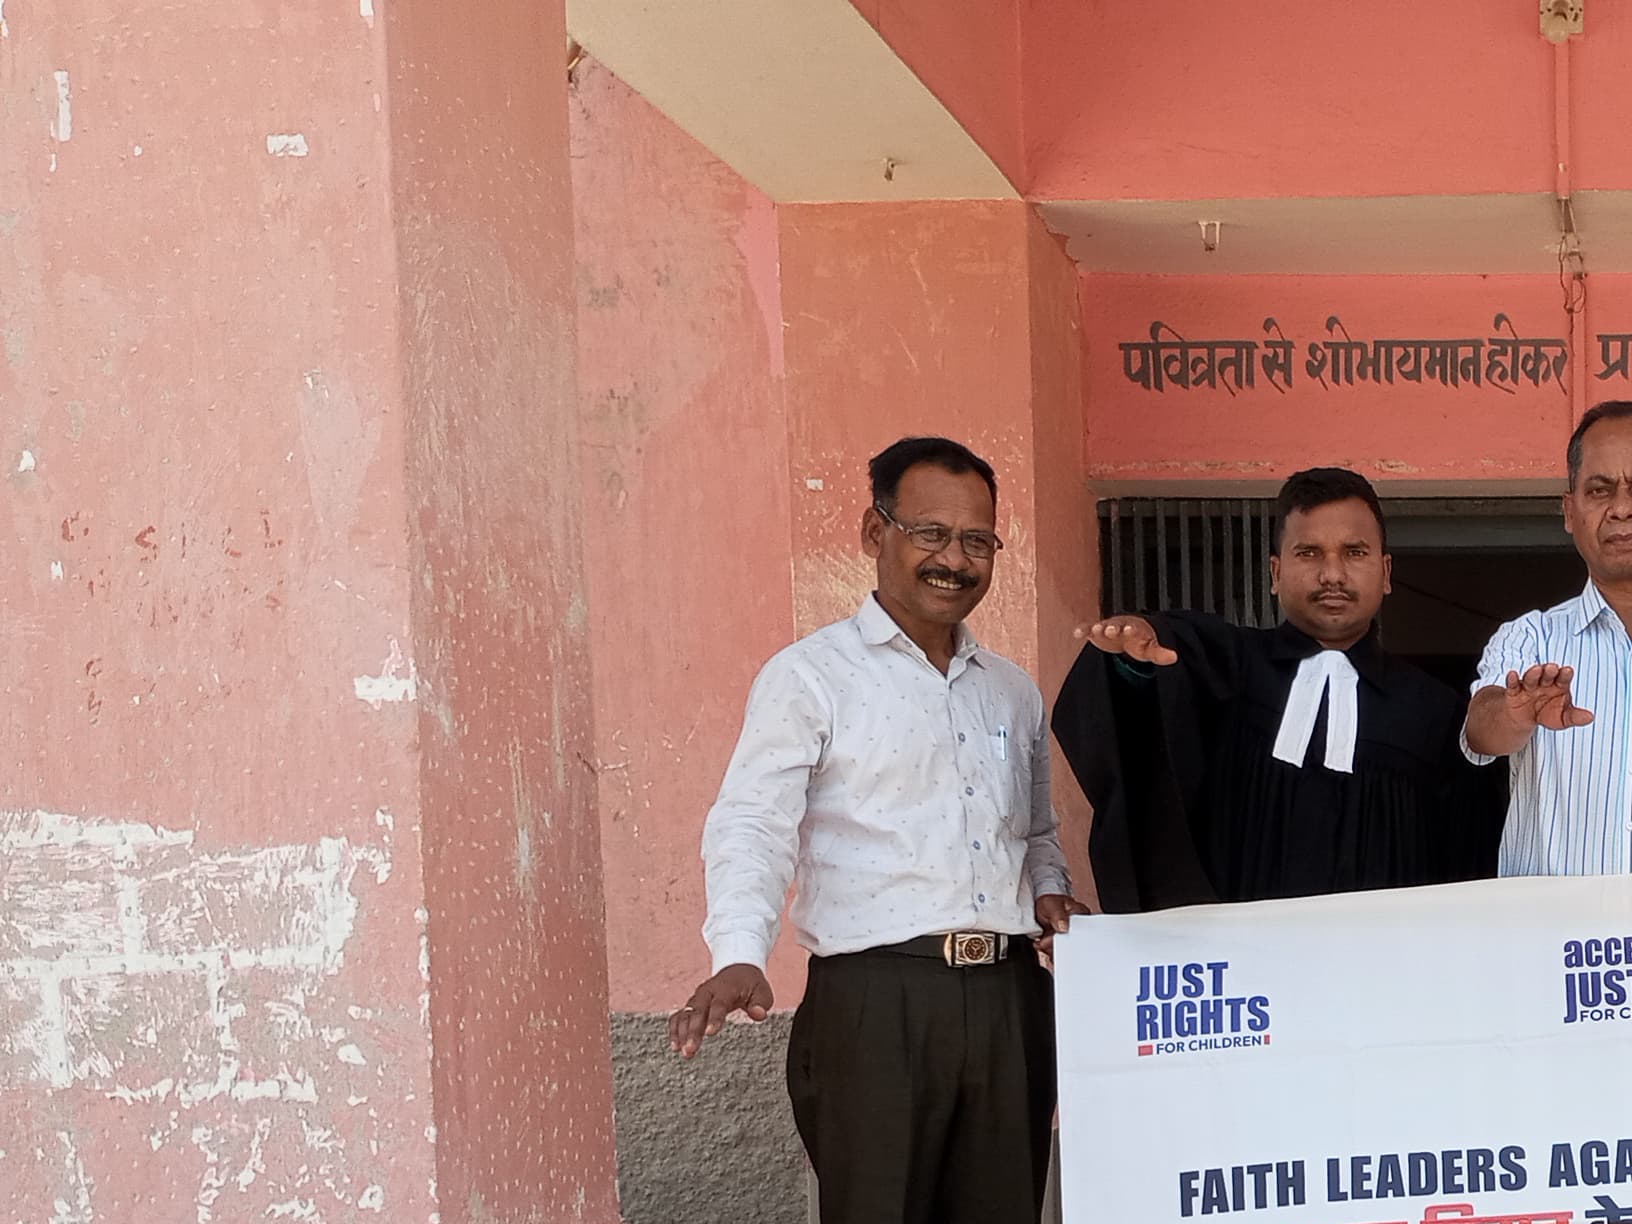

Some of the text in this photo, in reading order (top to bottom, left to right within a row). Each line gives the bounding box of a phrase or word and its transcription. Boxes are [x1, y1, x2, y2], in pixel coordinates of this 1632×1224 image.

[1119, 320, 1258, 397] पवित्रता
[1261, 317, 1294, 394] से
[1136, 961, 1229, 1003] JUST
[1136, 995, 1270, 1042] RIGHTS
[1580, 1008, 1615, 1022] FOR
[1156, 1035, 1262, 1055] FOR CHILDREN
[1180, 1160, 1305, 1218] FAITH
[1327, 1146, 1528, 1202] LEADERS
